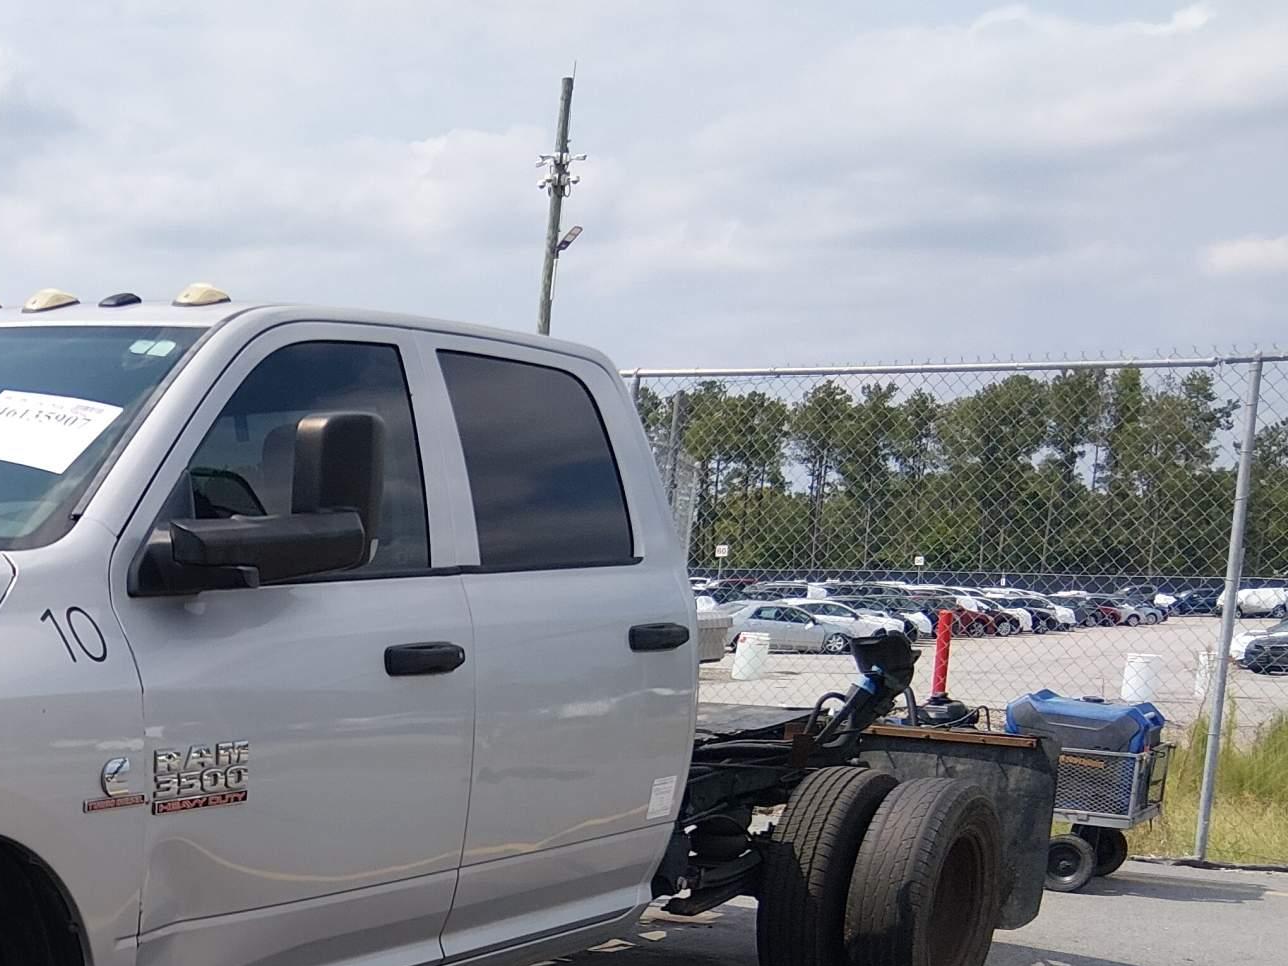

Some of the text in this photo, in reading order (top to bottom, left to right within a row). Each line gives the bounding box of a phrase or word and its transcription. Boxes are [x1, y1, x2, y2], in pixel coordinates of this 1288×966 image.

[40, 606, 107, 663] 10
[153, 740, 249, 774] RAM
[153, 764, 249, 799] 3500
[158, 791, 246, 813] HEAVY DUTY
